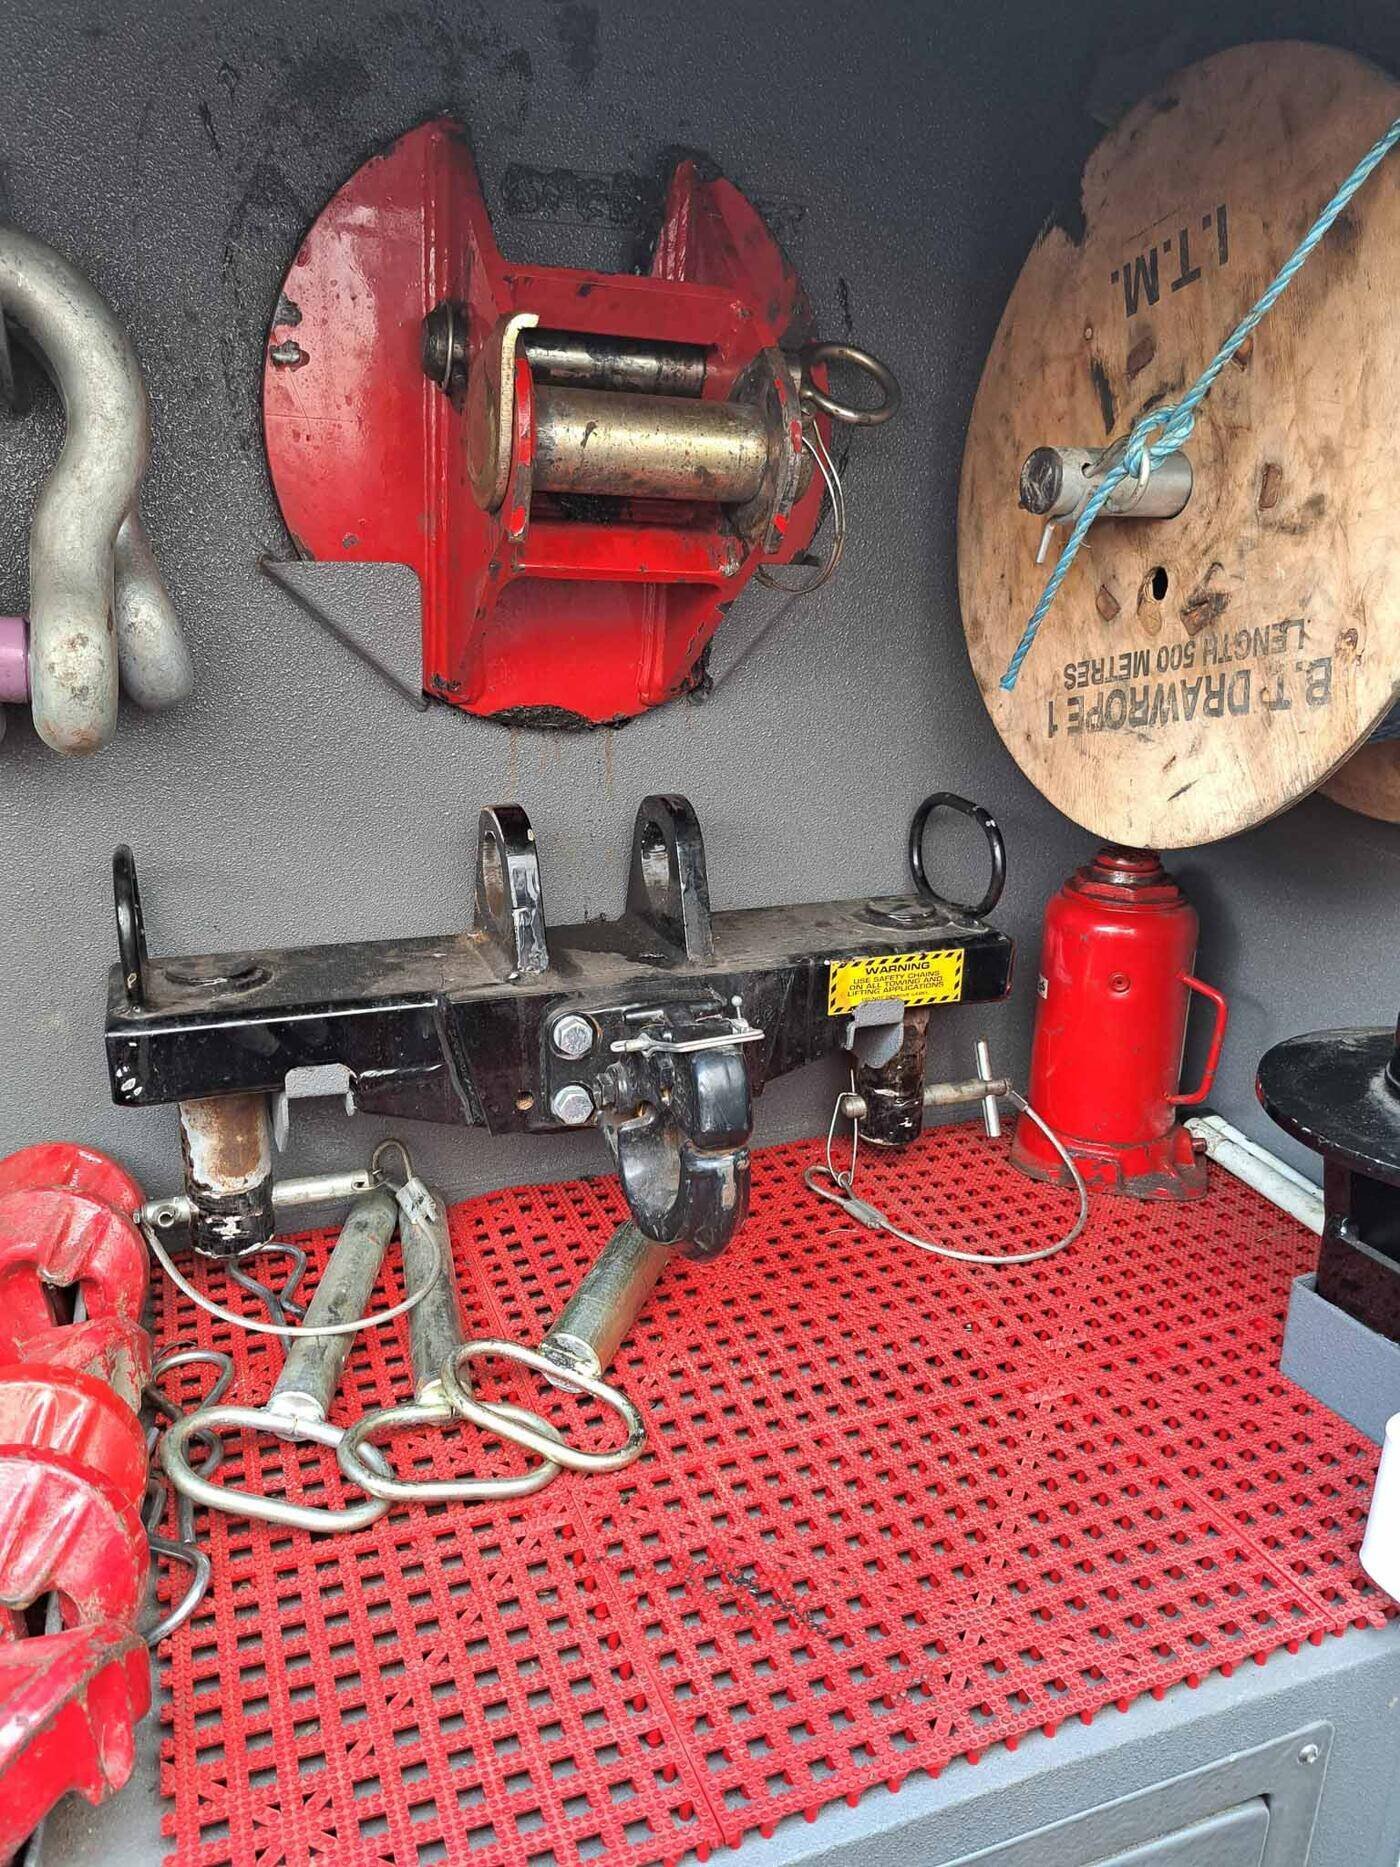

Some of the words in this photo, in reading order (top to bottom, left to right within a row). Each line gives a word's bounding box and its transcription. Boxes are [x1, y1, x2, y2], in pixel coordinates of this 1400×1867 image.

[1111, 204, 1228, 318] I.T.M.
[1156, 640, 1195, 673] 500
[1203, 619, 1305, 665] LENGTH
[1063, 649, 1150, 690] METRES
[1047, 701, 1059, 739] 1
[1067, 670, 1251, 736] DRAWROPE
[853, 977, 872, 985] USE
[873, 974, 904, 983] SAFETY
[907, 970, 941, 979] CHAINS
[866, 962, 930, 975] WARNING
[866, 982, 882, 990] ALL
[885, 979, 921, 987] TOWING
[923, 975, 943, 983] AND
[847, 989, 880, 997] LIFTING
[883, 981, 944, 993] APPLICATIONS
